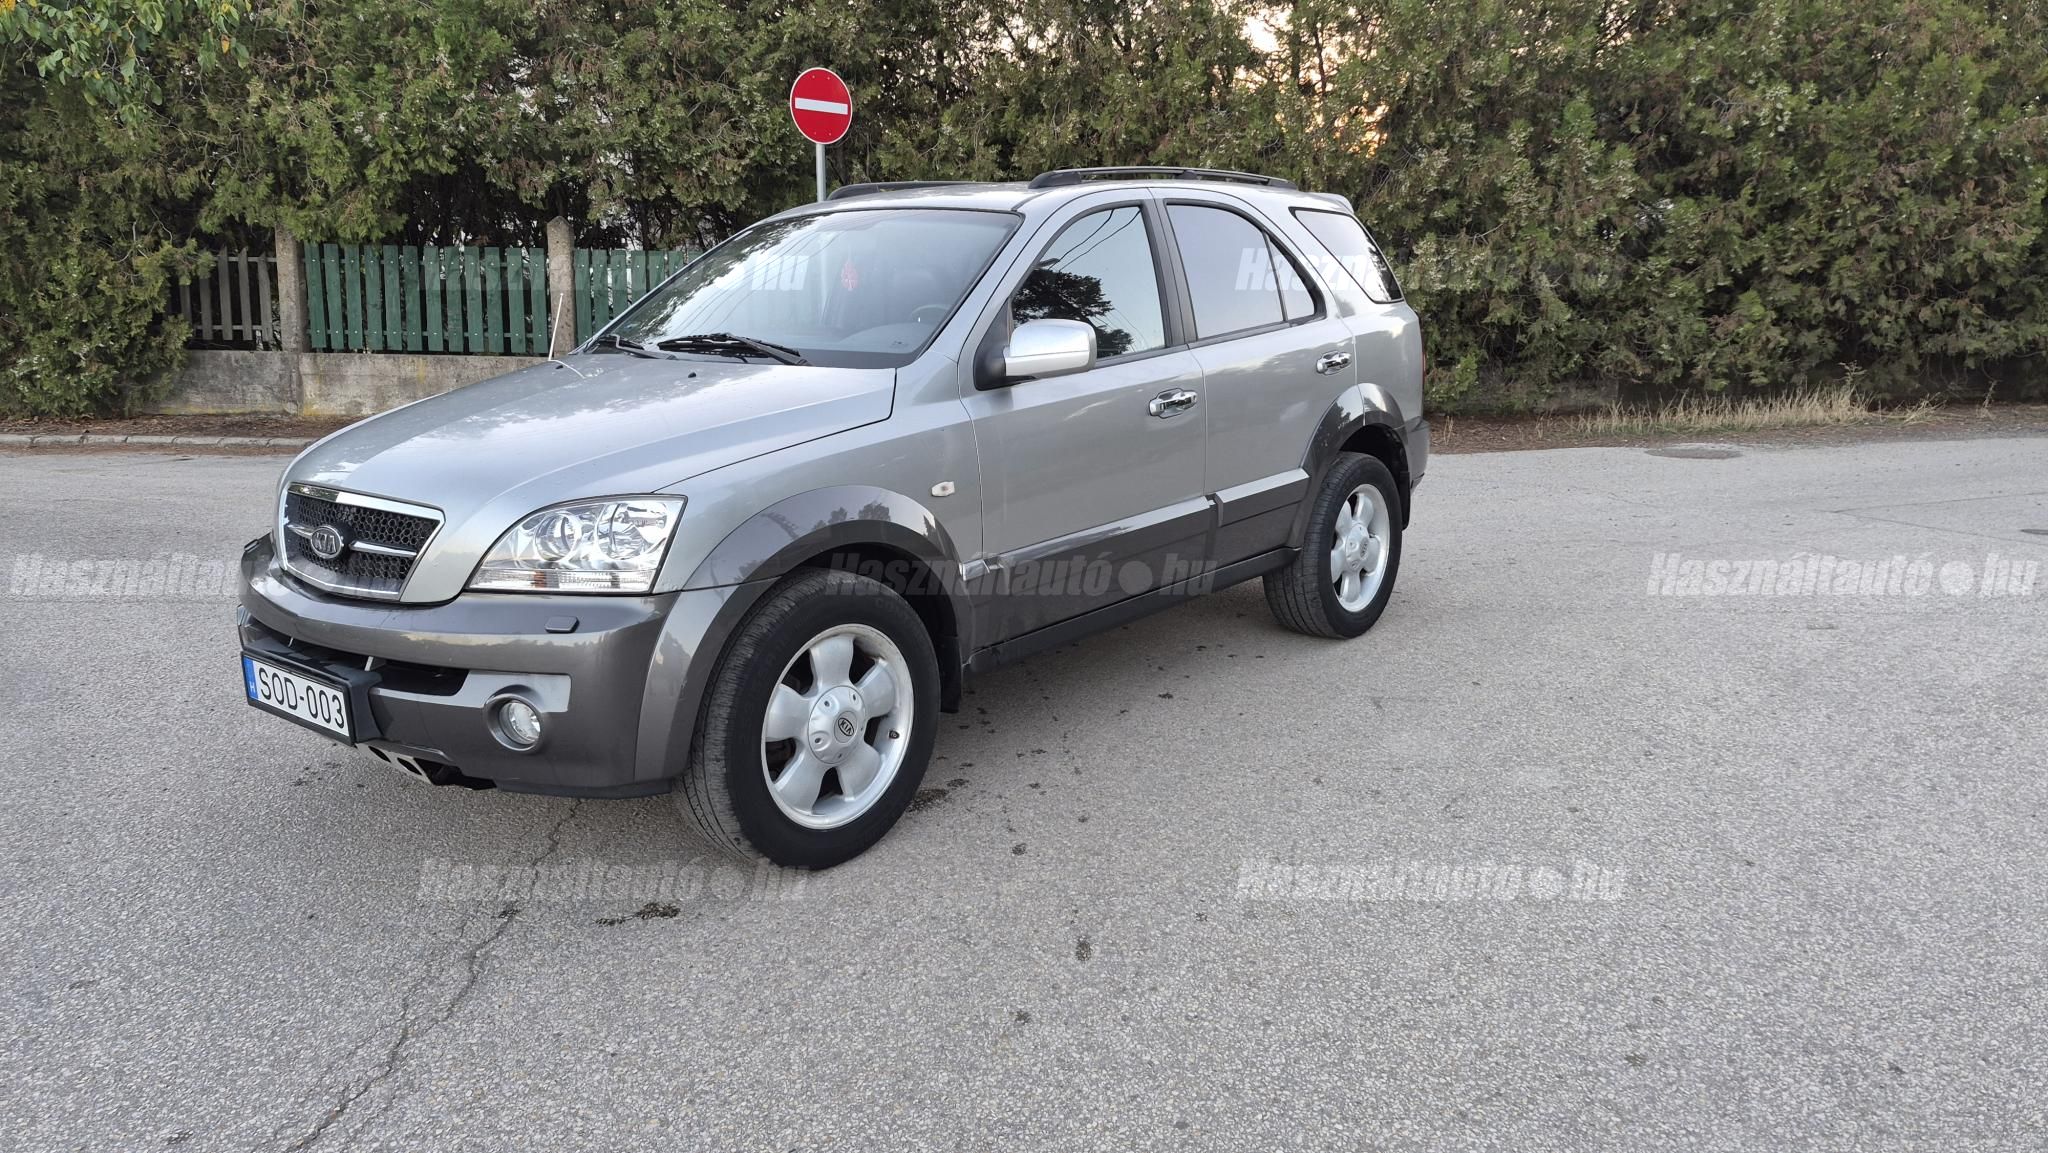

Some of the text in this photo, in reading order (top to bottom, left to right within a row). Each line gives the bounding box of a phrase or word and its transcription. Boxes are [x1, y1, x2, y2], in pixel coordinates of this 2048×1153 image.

[314, 531, 338, 554] KIA
[248, 682, 256, 693] H
[258, 667, 345, 729] SOD-003
[839, 718, 853, 735] KIA
